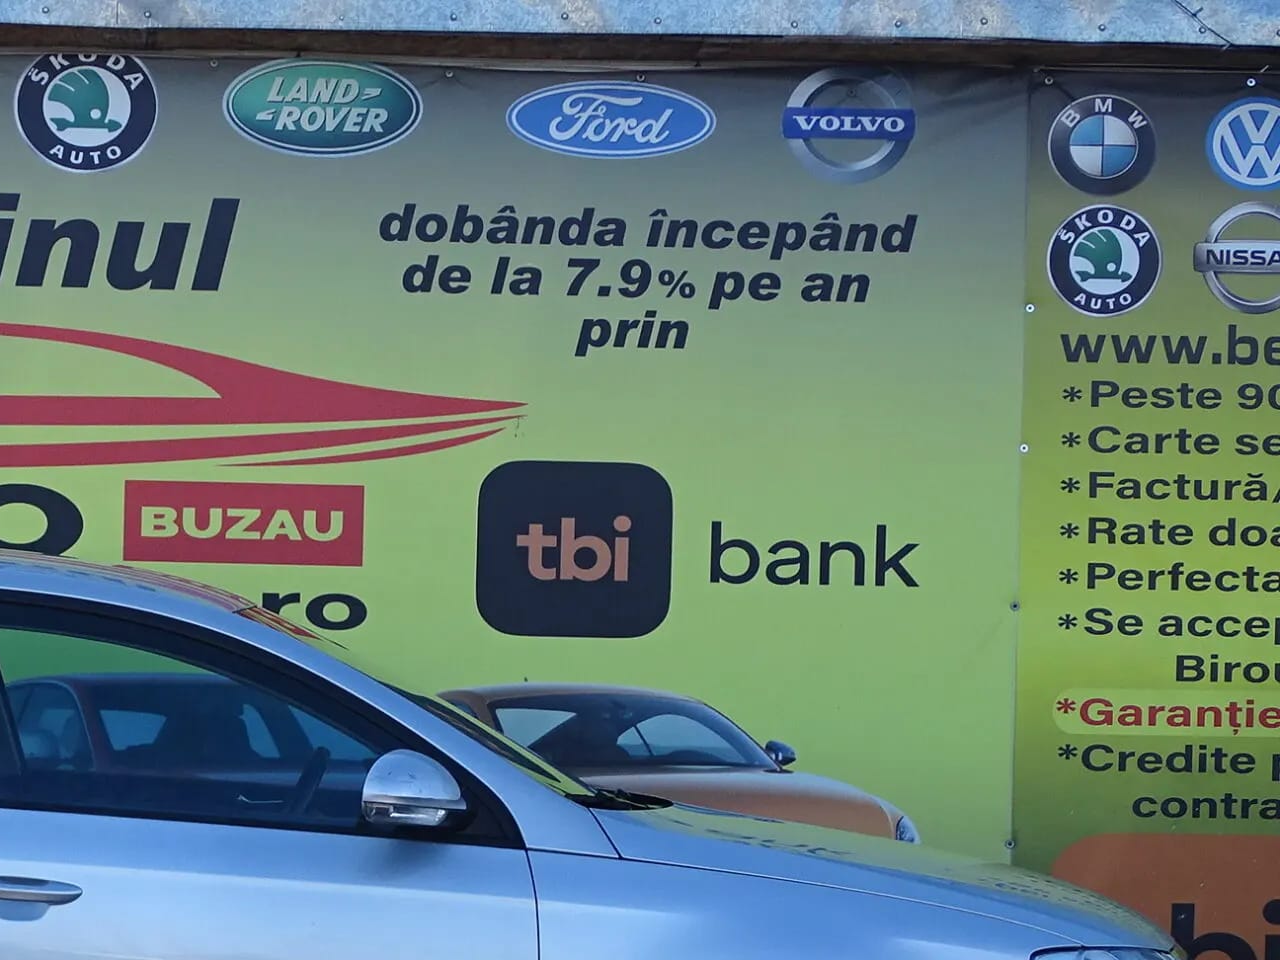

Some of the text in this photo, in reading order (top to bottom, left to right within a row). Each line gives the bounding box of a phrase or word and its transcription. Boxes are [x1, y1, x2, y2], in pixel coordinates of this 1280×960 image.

[267, 76, 360, 105] LAND
[275, 106, 388, 132] ROVER
[549, 93, 674, 145] Ford
[793, 114, 905, 133] VOLVO
[1060, 98, 1147, 130] BMW
[49, 144, 122, 165] AUTO
[380, 203, 918, 259] dobânda începând
[1058, 209, 1152, 248] ŠKODA
[403, 255, 870, 309] de la 7.9% pe an
[1074, 292, 1133, 310] AUTO
[575, 310, 688, 356] prin
[141, 506, 343, 541] BUZAU
[517, 516, 919, 587] tbi bank
[1176, 654, 1280, 683] Biro
